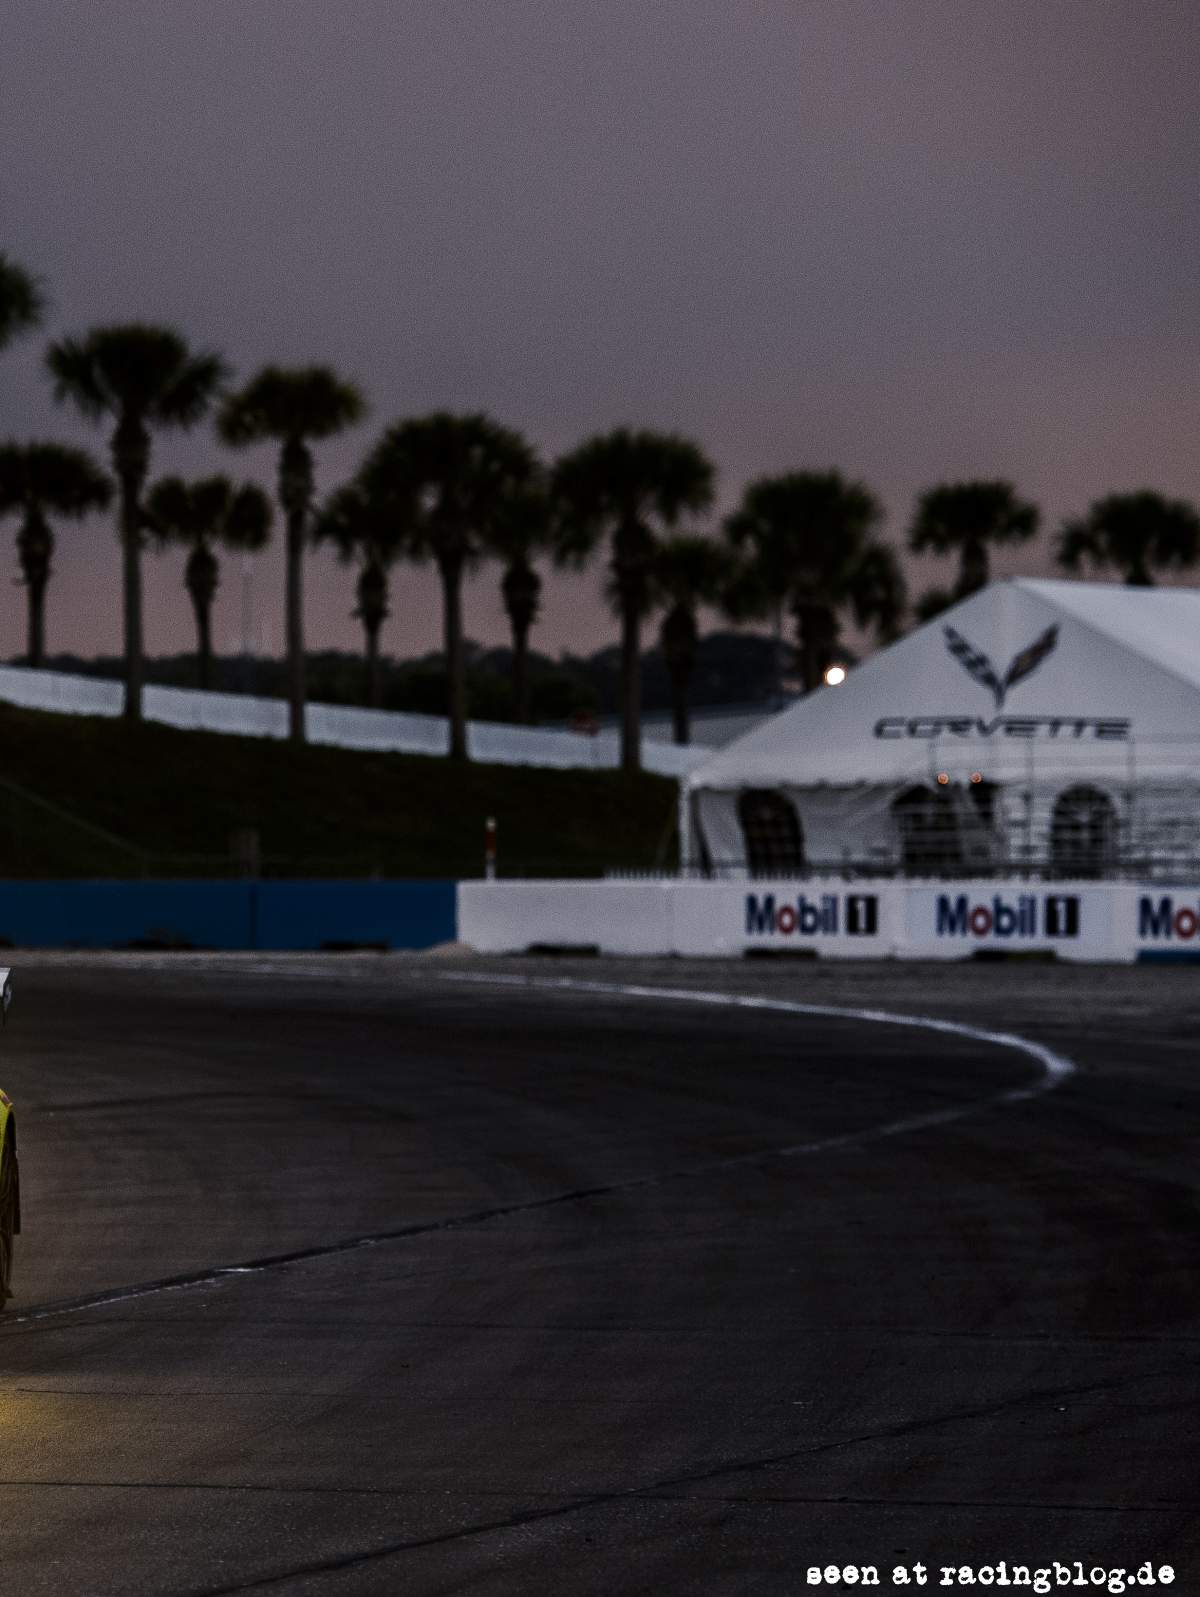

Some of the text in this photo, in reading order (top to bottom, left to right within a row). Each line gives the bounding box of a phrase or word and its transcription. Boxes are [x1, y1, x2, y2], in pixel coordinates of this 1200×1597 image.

[874, 715, 1131, 740] CORVETTE
[746, 893, 838, 936] Mobil
[936, 893, 1037, 937] Mobil
[1139, 894, 1200, 939] Mo
